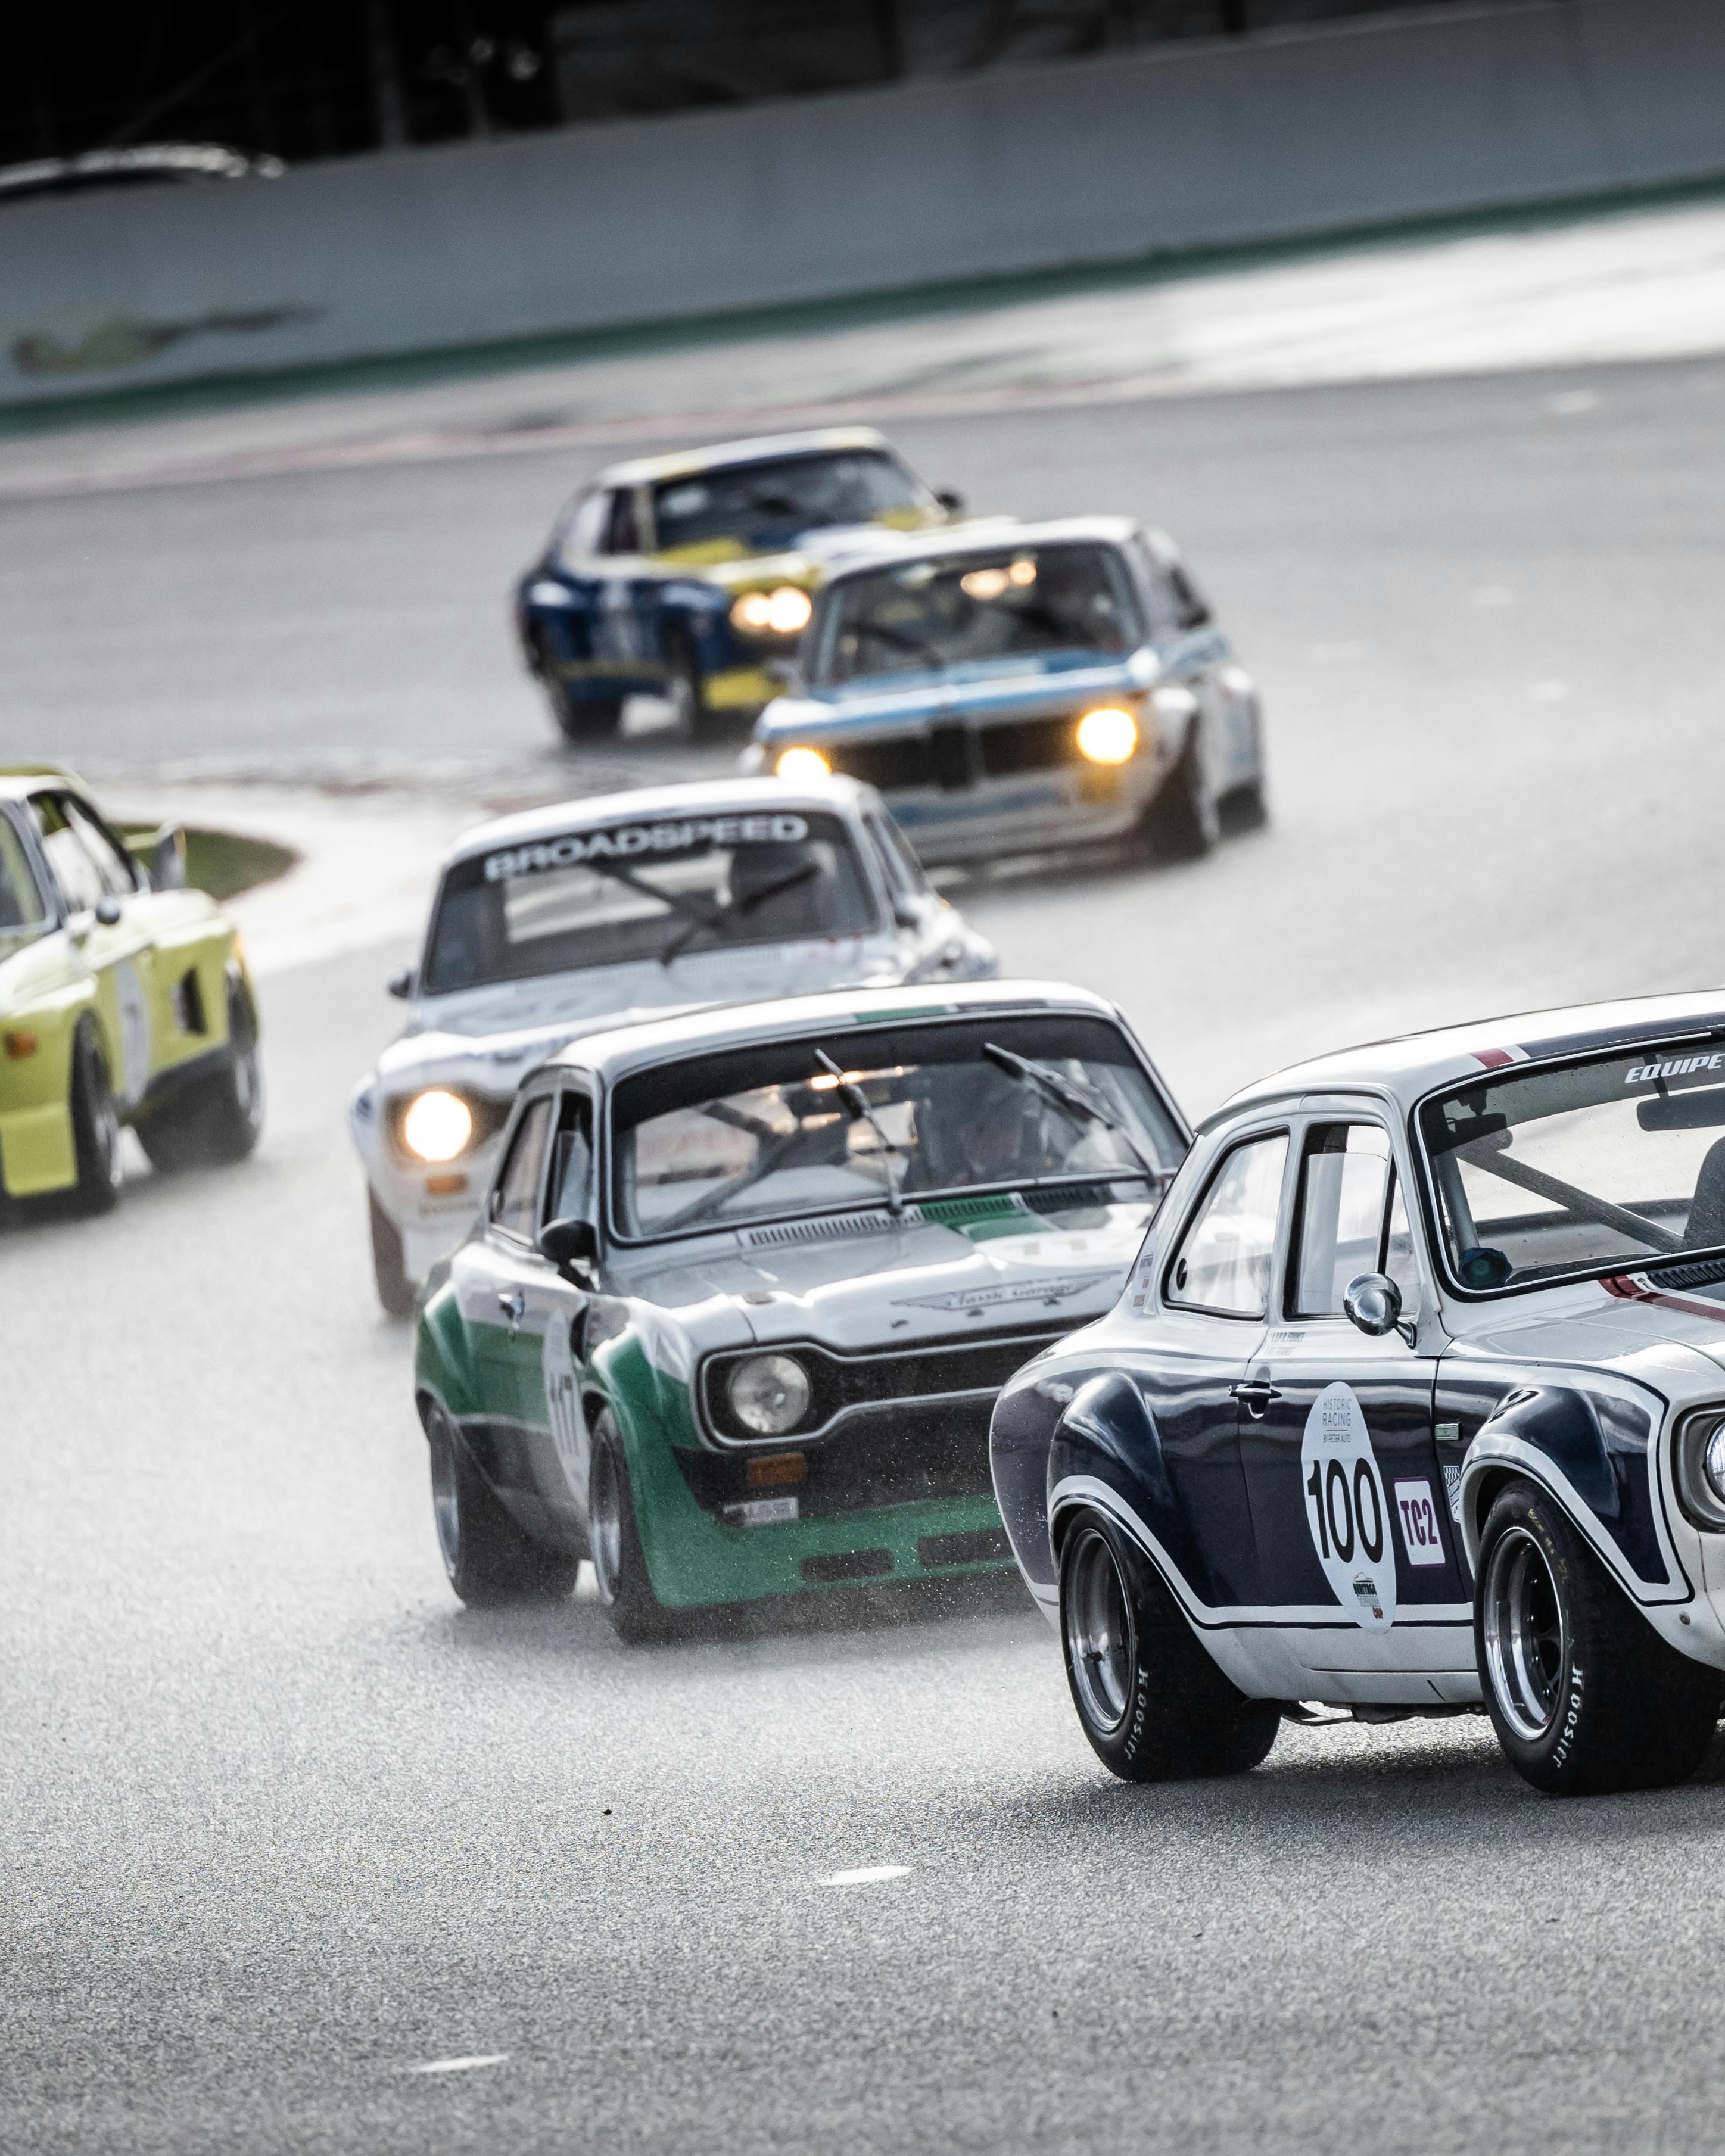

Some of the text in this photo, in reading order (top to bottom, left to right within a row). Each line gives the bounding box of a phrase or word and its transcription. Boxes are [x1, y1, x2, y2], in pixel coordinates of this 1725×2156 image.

[485, 815, 808, 884] BROADSPEED
[1624, 1053, 1725, 1083] EQUIPE
[1322, 1398, 1352, 1410] HISTORIC
[1322, 1412, 1352, 1426] RACING
[1307, 1457, 1384, 1563] 100
[1400, 1498, 1438, 1546] TC2
